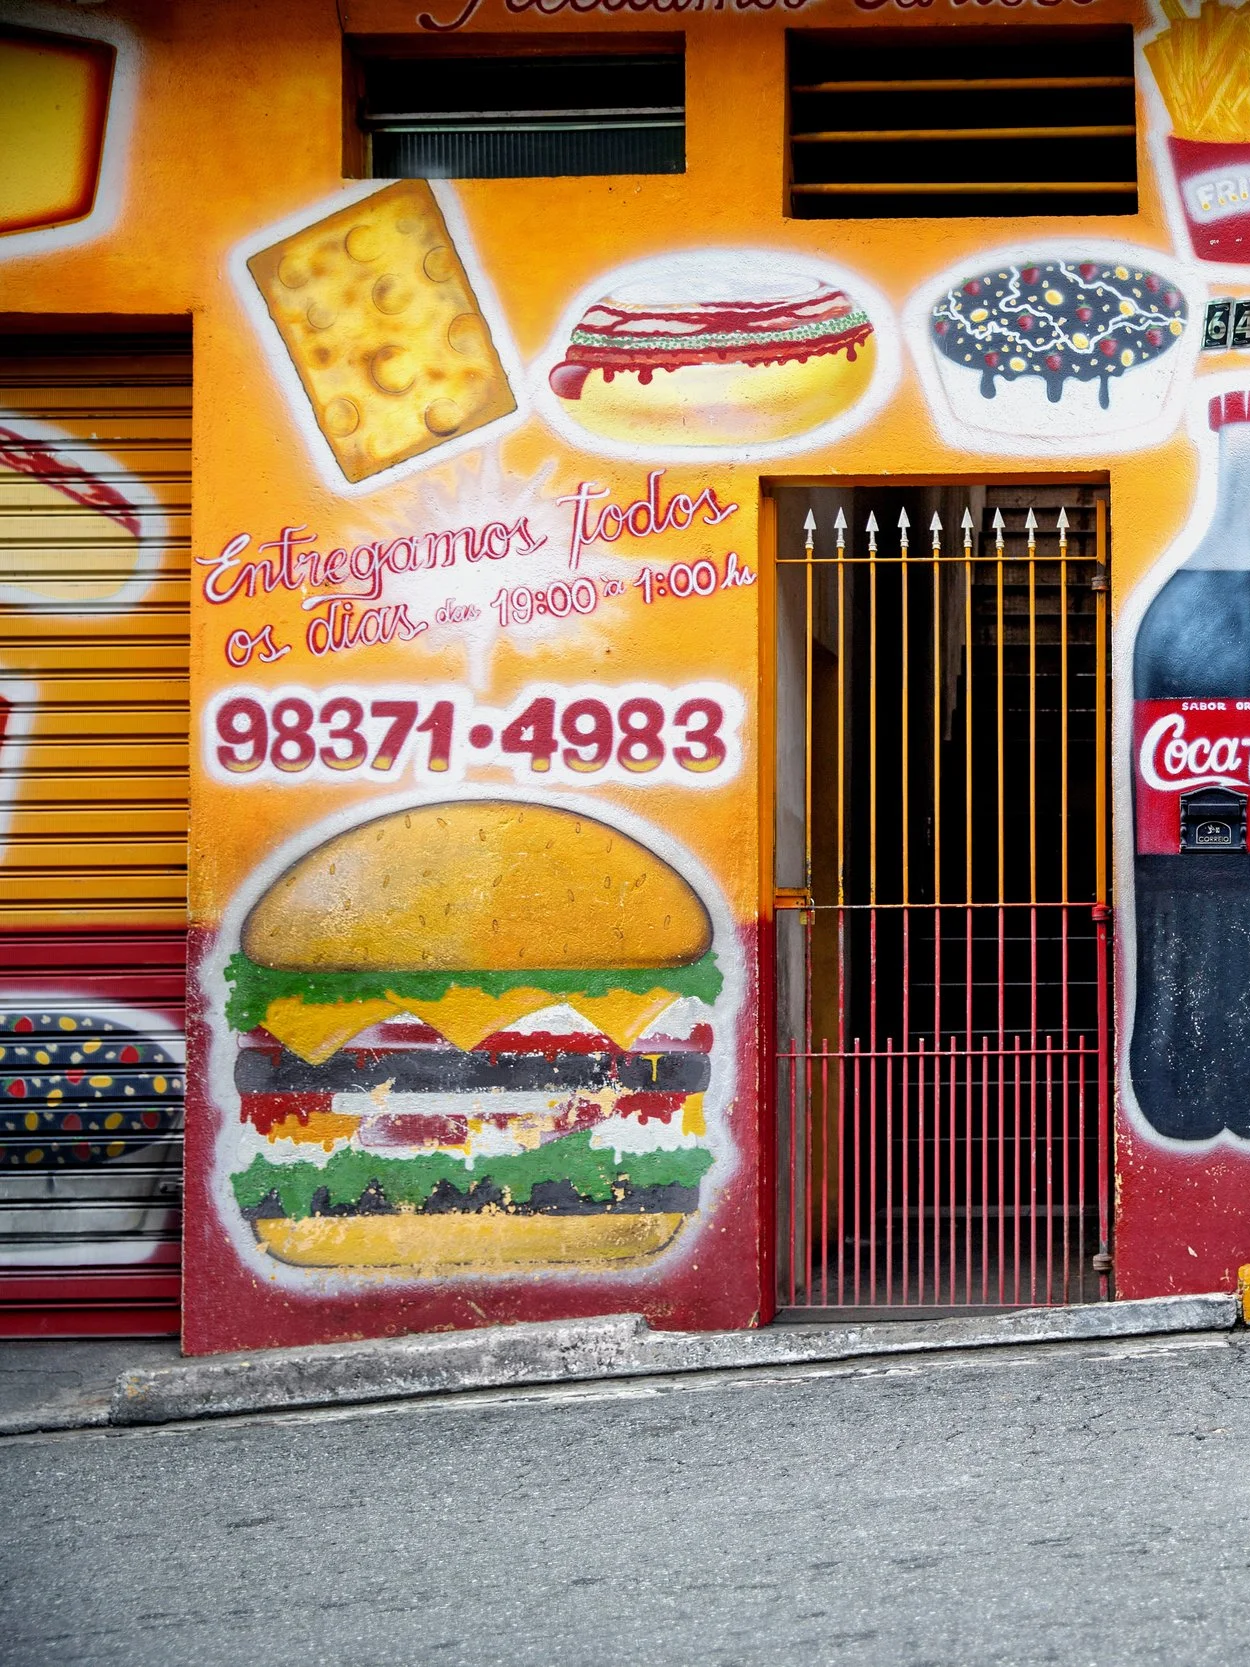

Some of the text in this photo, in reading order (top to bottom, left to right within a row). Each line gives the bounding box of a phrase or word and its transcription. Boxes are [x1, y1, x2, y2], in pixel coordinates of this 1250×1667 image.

[196, 516, 547, 610] Entregamos
[225, 625, 292, 667] os
[306, 598, 428, 657] dias
[436, 598, 482, 624] das
[494, 578, 597, 627] 19:00
[634, 560, 716, 604] 1:00
[720, 552, 757, 589] hs
[1181, 702, 1227, 711] SABOR
